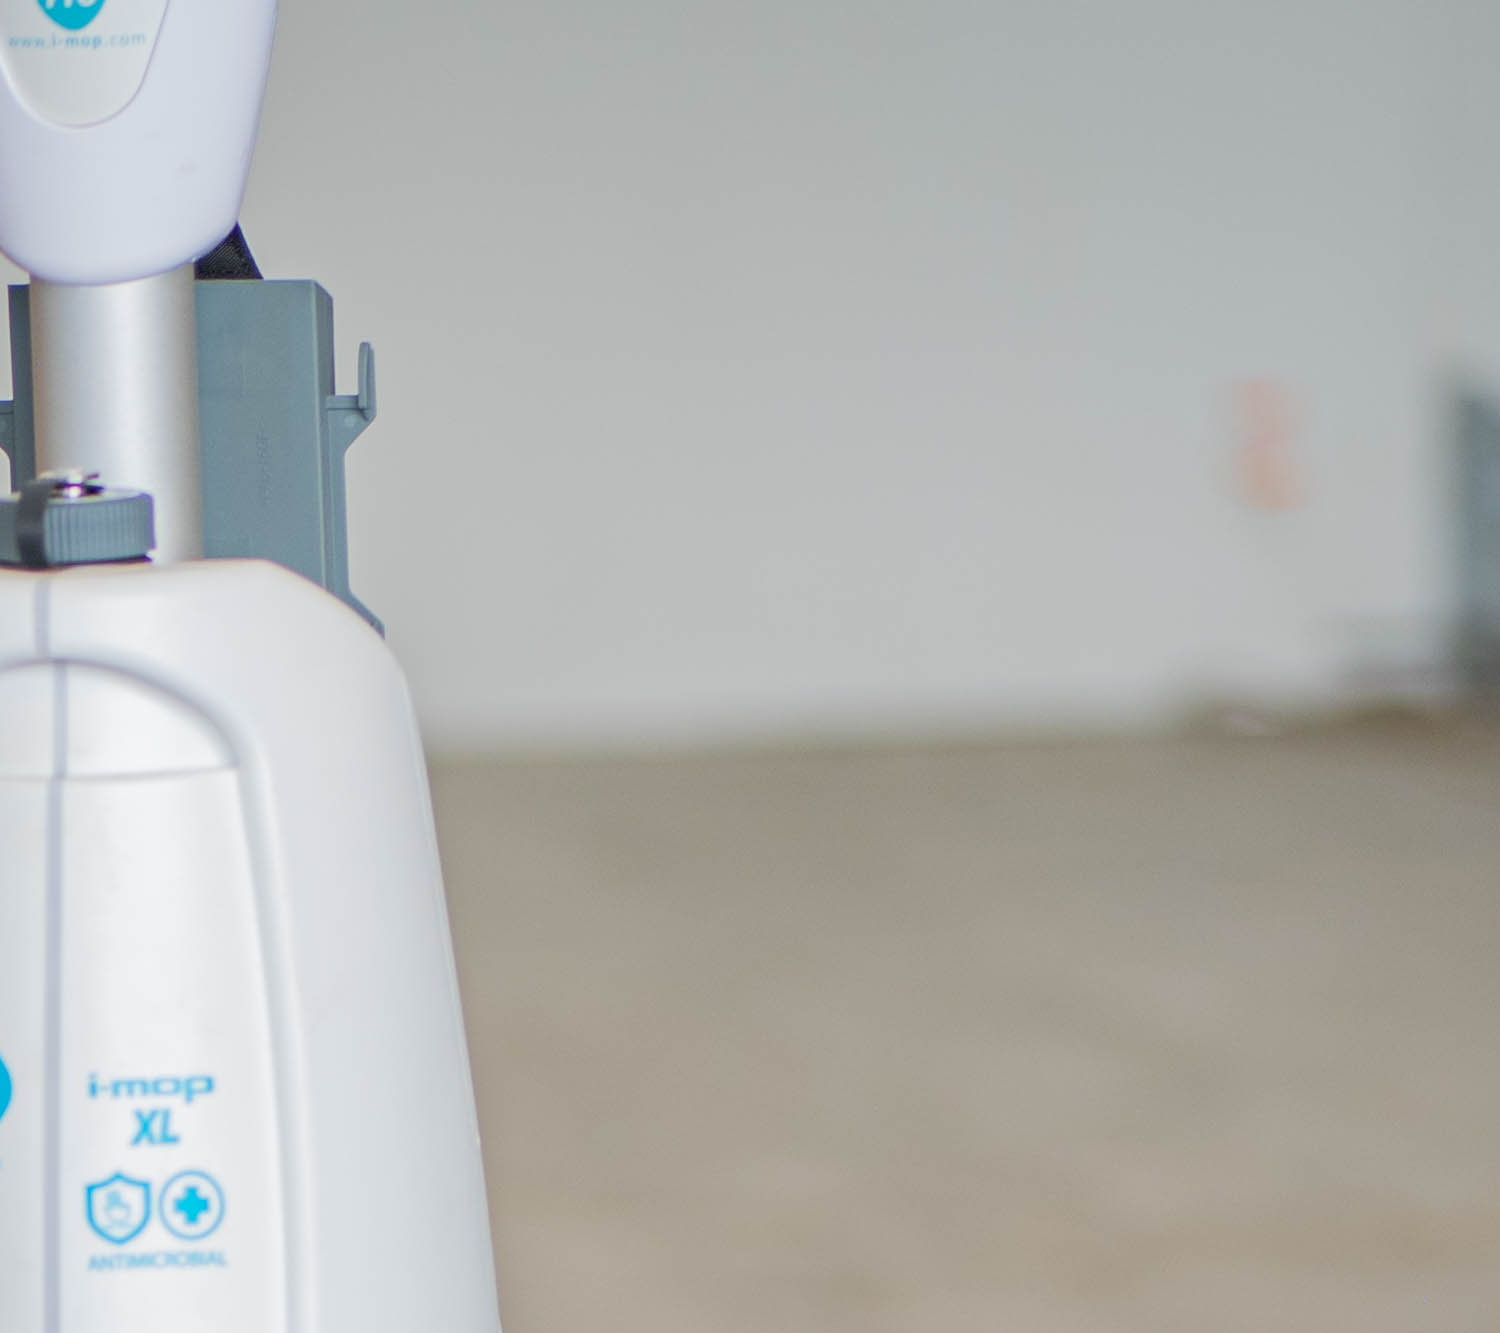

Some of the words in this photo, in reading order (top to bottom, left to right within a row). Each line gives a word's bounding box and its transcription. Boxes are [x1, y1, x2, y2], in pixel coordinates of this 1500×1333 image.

[8, 32, 147, 50] www.i-mop.com
[87, 1072, 215, 1103] i-mop
[130, 1107, 181, 1146] XL
[87, 1250, 229, 1272] ANTIMICROBIAL
